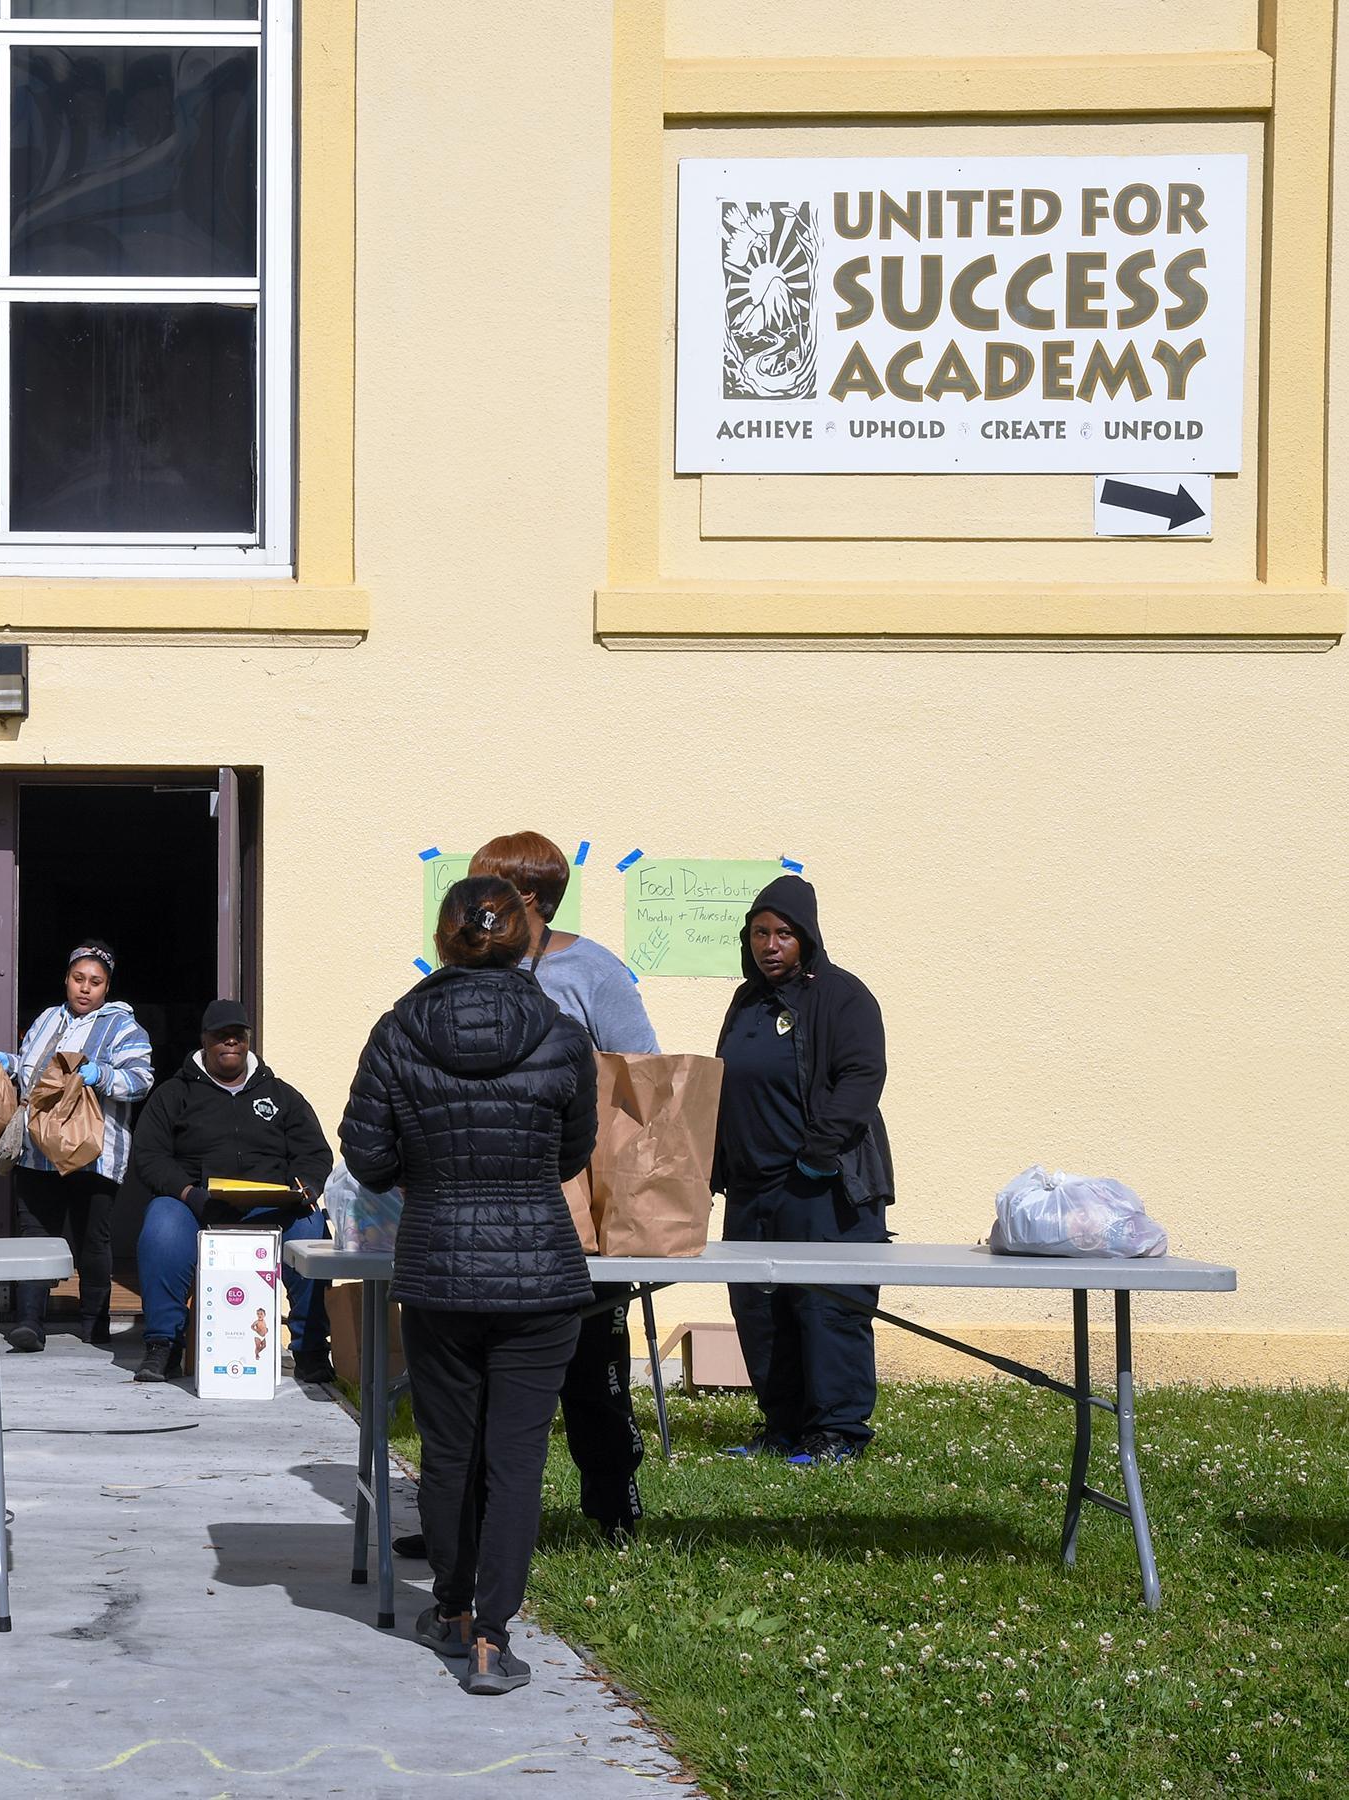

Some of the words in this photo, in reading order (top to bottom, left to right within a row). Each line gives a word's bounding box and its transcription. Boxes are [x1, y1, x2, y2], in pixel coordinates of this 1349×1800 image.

[833, 188, 1062, 242] UNITED
[1081, 182, 1209, 237] FOR
[834, 248, 1207, 331] SUCCESS
[828, 338, 1207, 403] ACADEMY
[716, 419, 813, 440] ACHIEVE
[849, 419, 945, 439] UPHOLD
[980, 419, 1067, 440] CREATE
[1104, 419, 1204, 440] UNFOLD
[640, 867, 674, 896] Food
[680, 868, 760, 897] Distributio
[638, 908, 673, 926] Monday
[689, 907, 740, 926] Thursday
[631, 926, 669, 970] FREE
[265, 1273, 272, 1281] 6
[612, 1306, 625, 1334] OVE
[231, 1364, 239, 1374] 6
